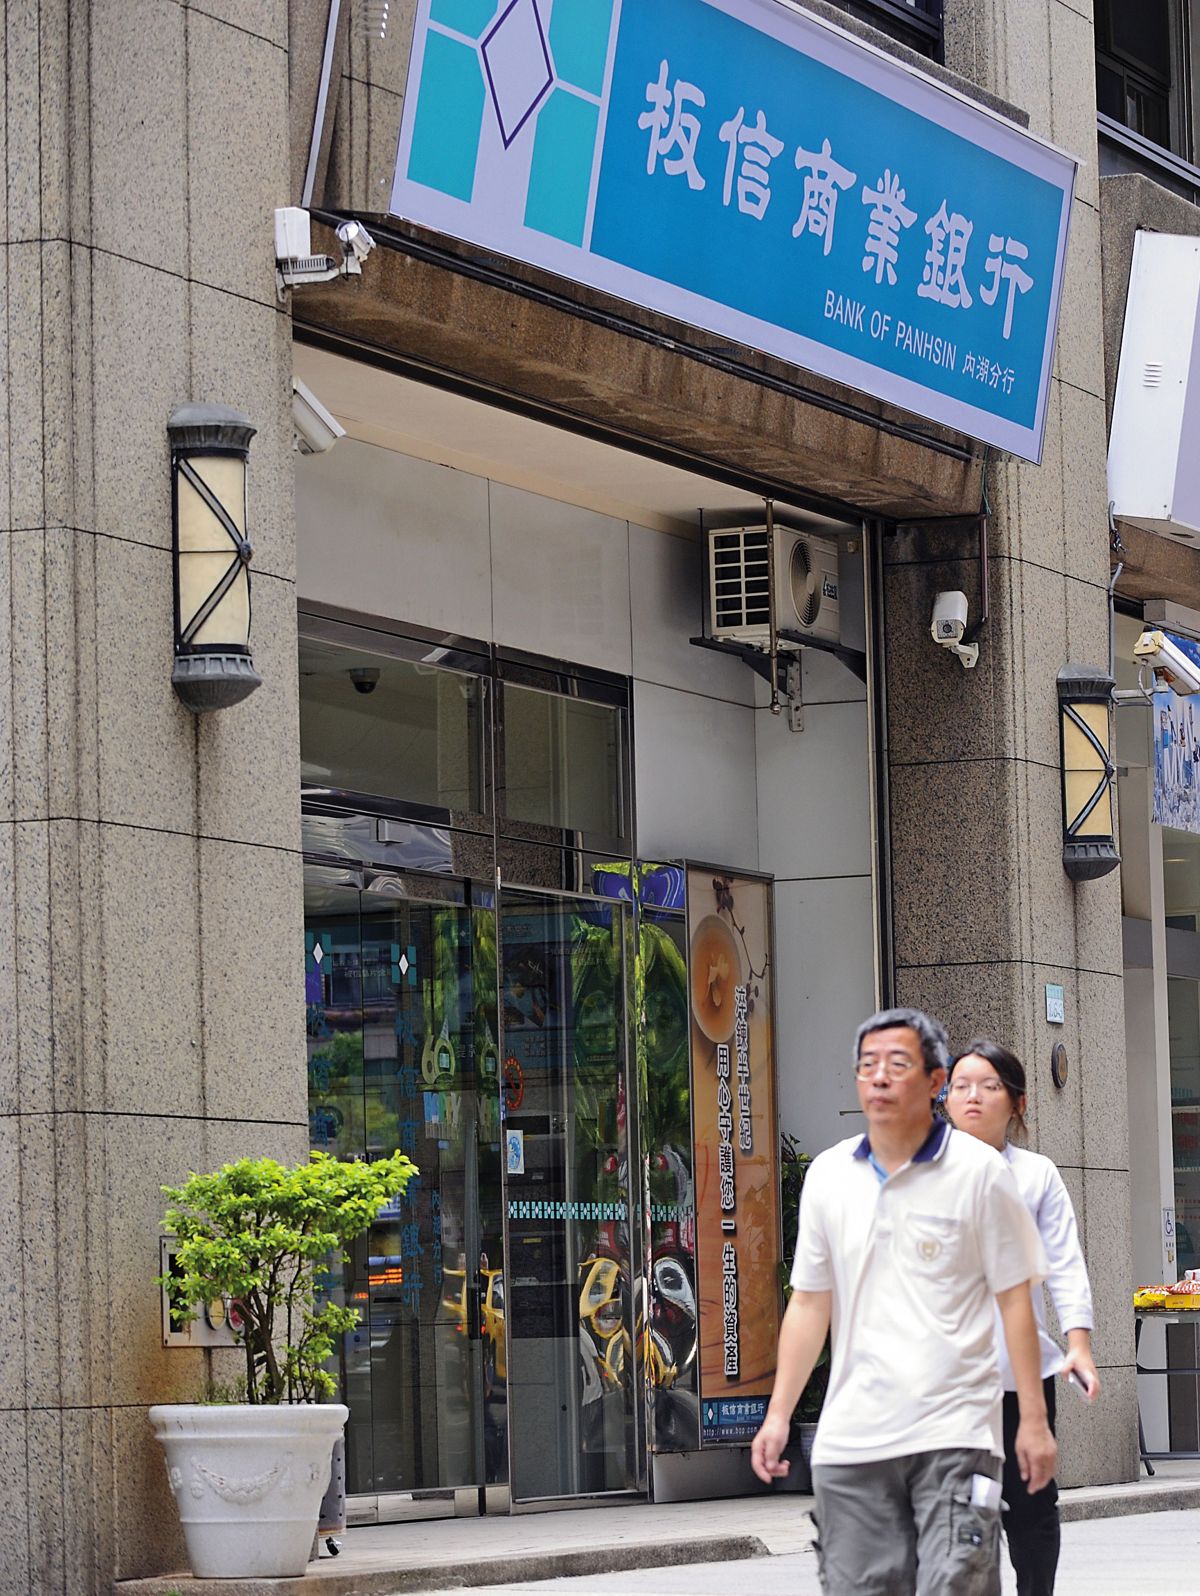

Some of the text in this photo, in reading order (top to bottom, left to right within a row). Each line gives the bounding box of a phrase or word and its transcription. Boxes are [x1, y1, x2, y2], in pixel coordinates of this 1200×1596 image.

[637, 59, 1034, 340] 板信商業銀行
[824, 289, 957, 371] BANK OF PANHSIN
